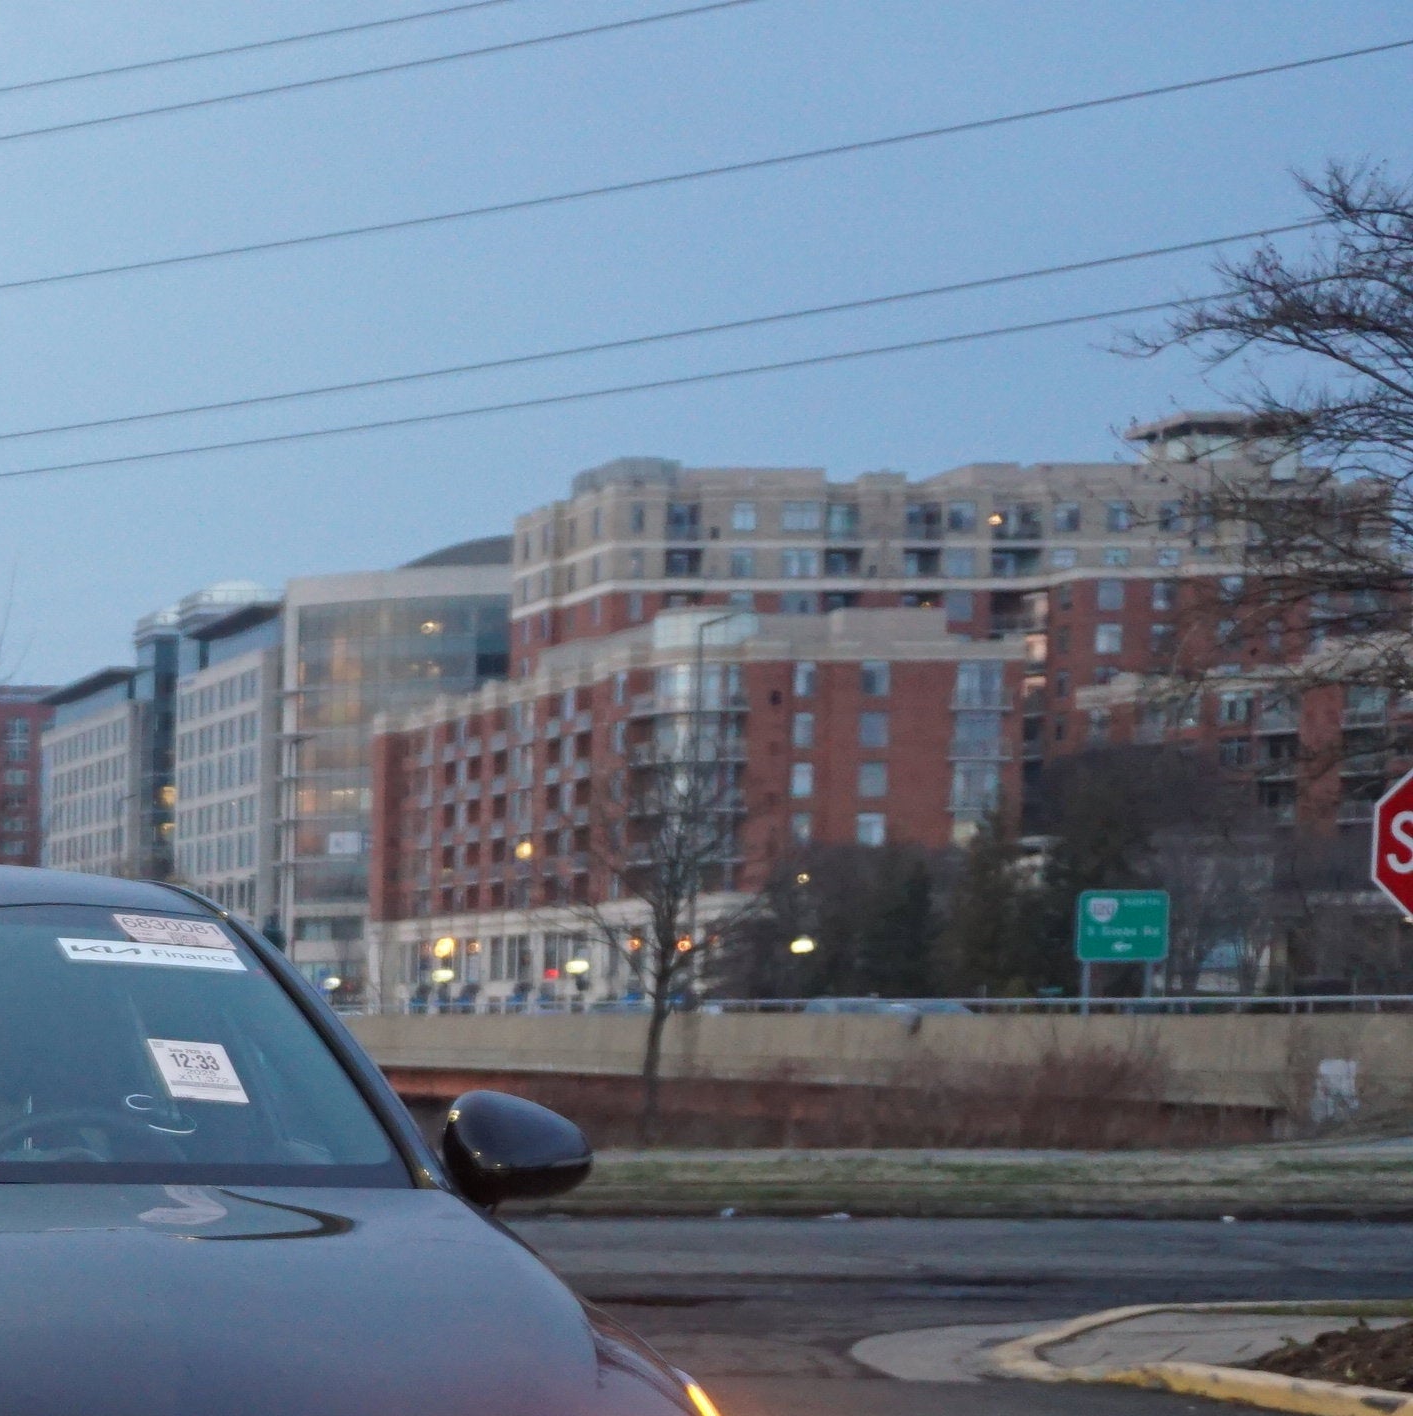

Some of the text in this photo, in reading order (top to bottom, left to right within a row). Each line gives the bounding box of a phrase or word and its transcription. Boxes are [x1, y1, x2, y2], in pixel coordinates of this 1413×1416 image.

[122, 917, 220, 936] 6830081
[152, 949, 234, 963] Finance
[170, 1053, 220, 1071] 12:33
